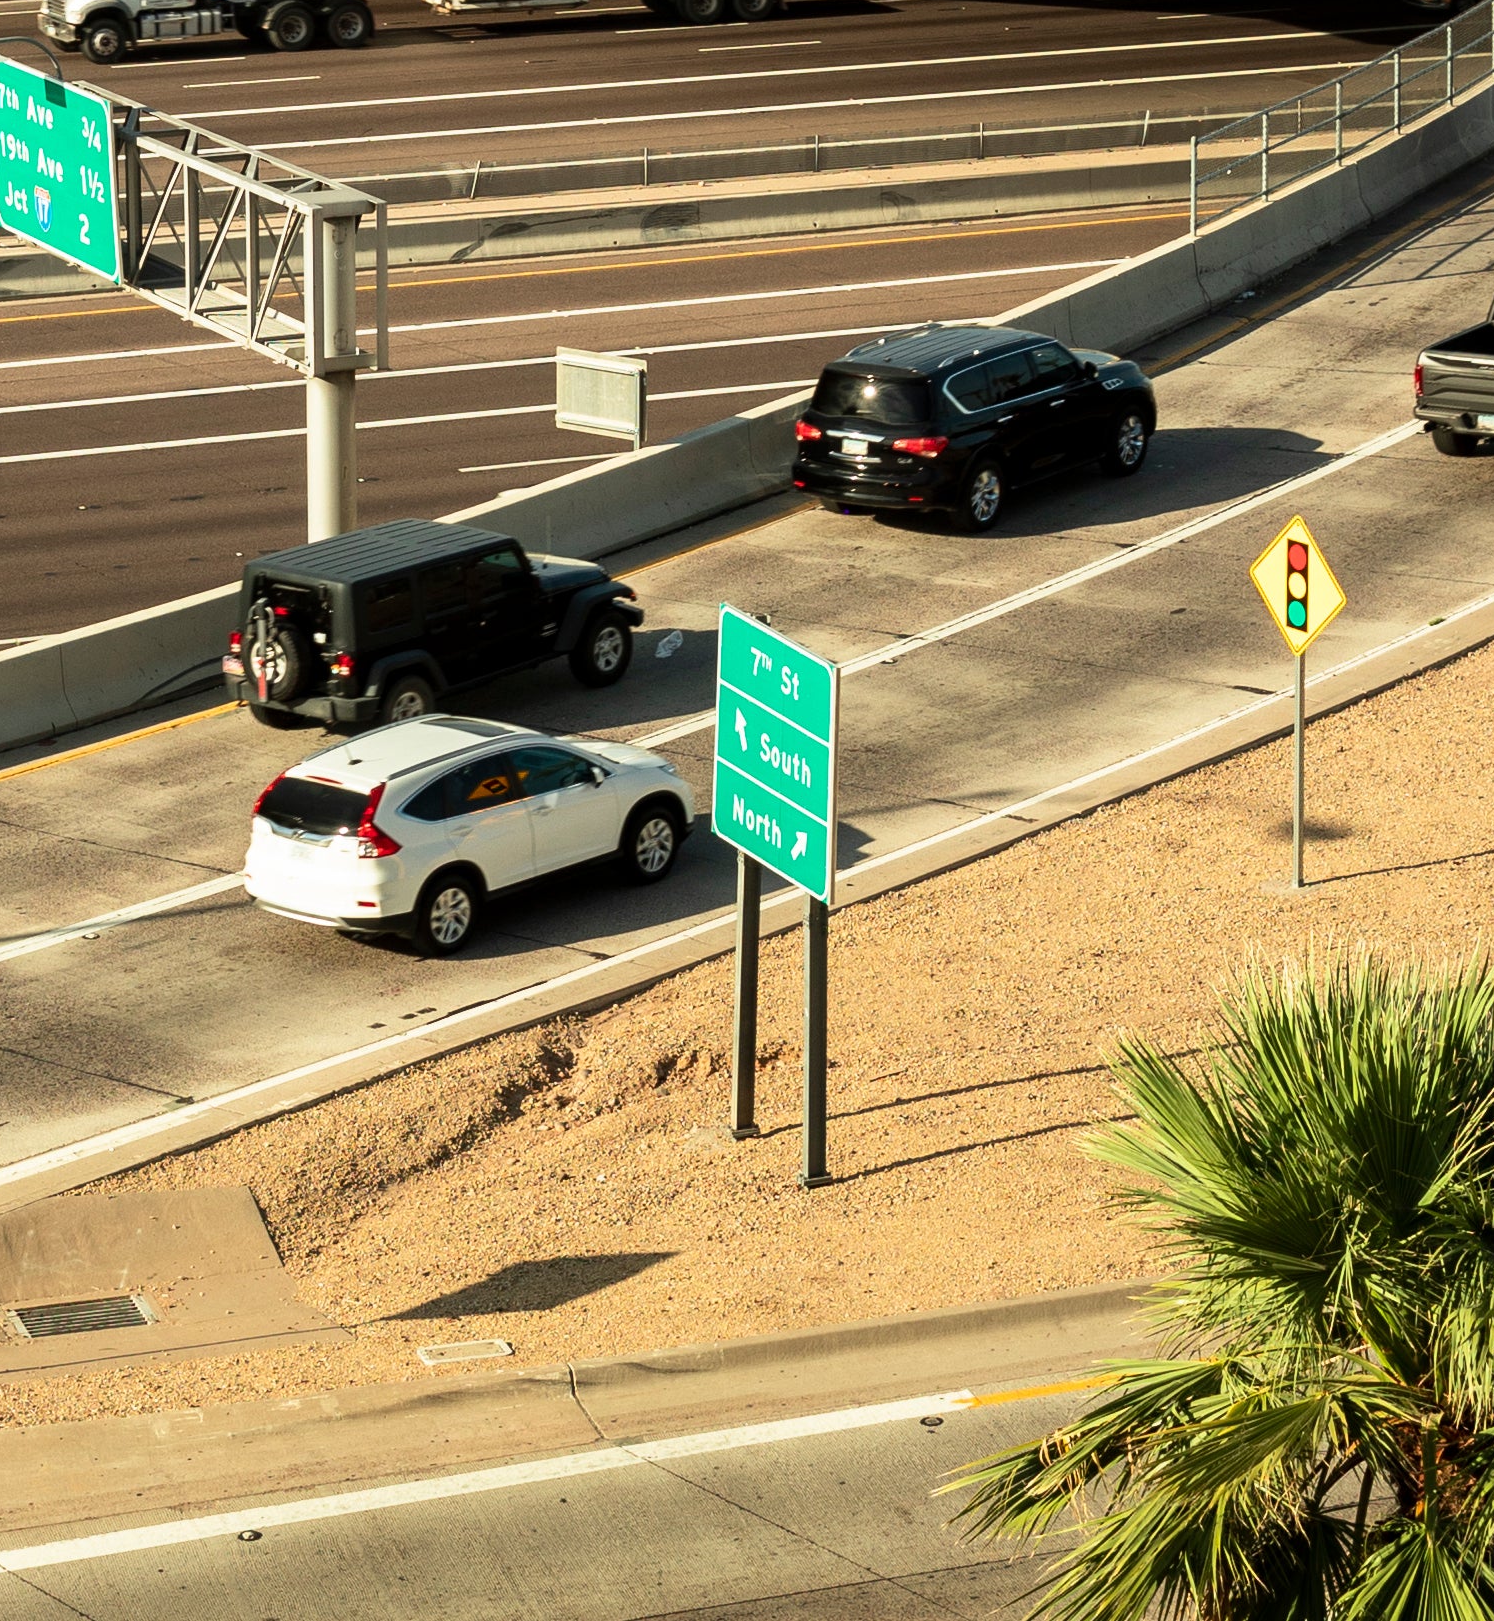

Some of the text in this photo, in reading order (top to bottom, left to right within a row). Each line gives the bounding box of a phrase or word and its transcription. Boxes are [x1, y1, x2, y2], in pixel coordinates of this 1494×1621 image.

[26, 95, 54, 130] Ave
[81, 116, 102, 153] 3/4
[0, 130, 30, 163] 19th
[36, 147, 64, 183] Ave
[4, 181, 91, 246] Jct 17 2
[750, 646, 800, 701] 7TH St
[759, 732, 812, 789] South
[732, 793, 782, 849] North
